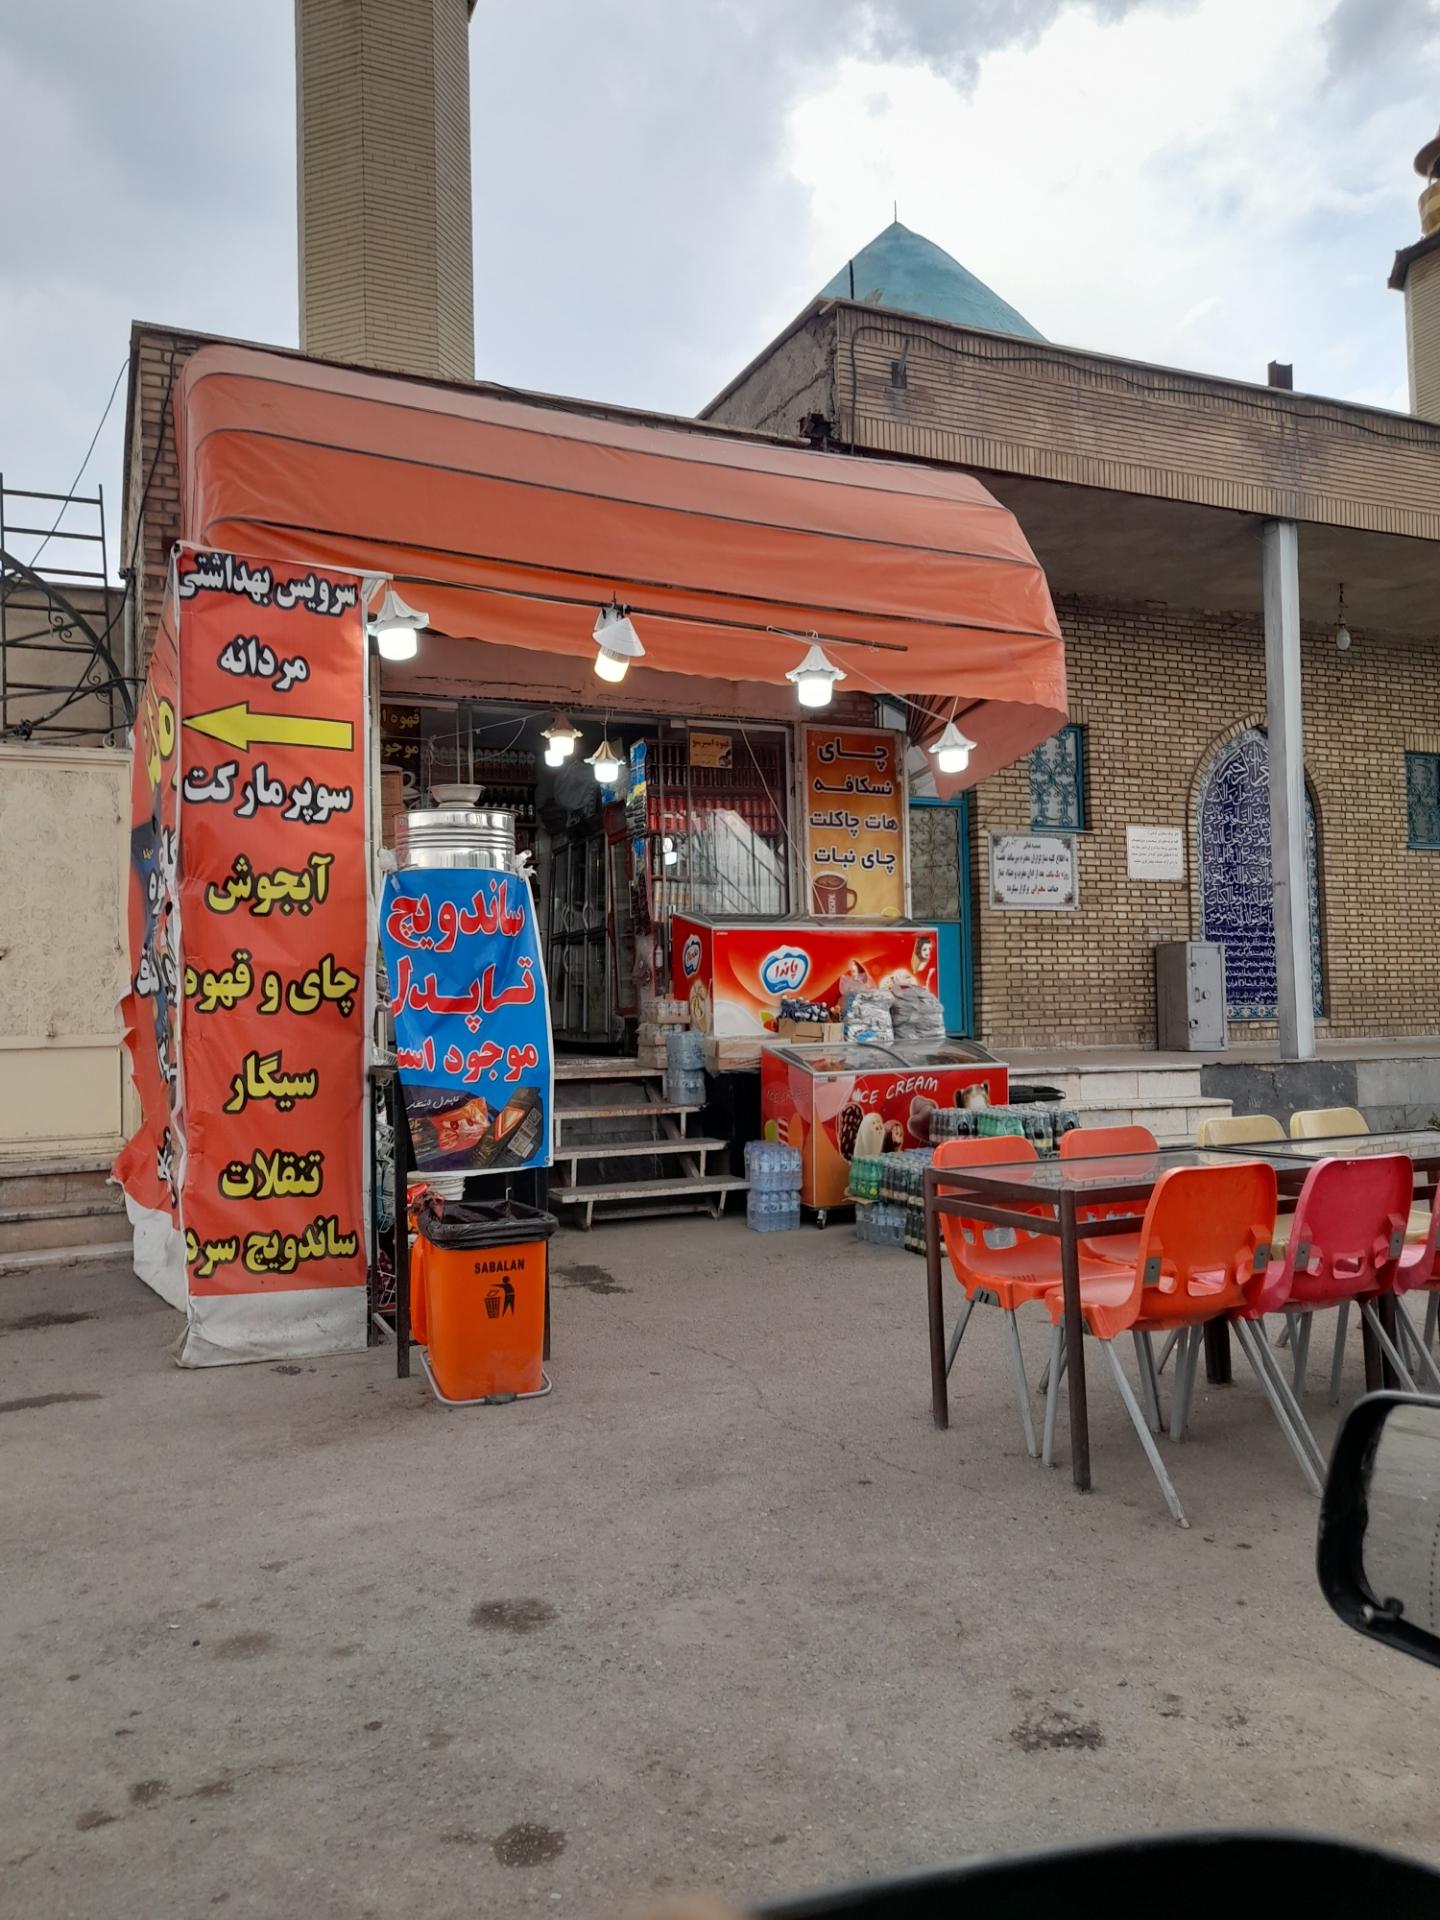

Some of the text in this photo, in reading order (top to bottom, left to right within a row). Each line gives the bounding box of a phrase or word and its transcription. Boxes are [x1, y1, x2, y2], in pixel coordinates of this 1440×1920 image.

[179, 554, 356, 613] سرویس بهداشتی
[220, 637, 307, 690] مردانه
[818, 738, 888, 769] چای
[814, 776, 893, 796] نسکافه
[810, 811, 898, 836] هات چاکلت
[814, 847, 896, 873] چای نبات
[209, 855, 332, 914] آبجوش
[386, 878, 525, 953] ساندویچ
[184, 951, 251, 1011] قهوه
[261, 973, 280, 1012] و
[289, 956, 357, 1014] چای
[225, 1054, 316, 1111] سیگار
[397, 1036, 539, 1083] موجود اس
[885, 1076, 939, 1099] CREAM
[221, 1152, 320, 1198] تنقلات
[186, 1218, 357, 1276] ساندویچ سرد
[474, 1258, 526, 1275] SABALAN
